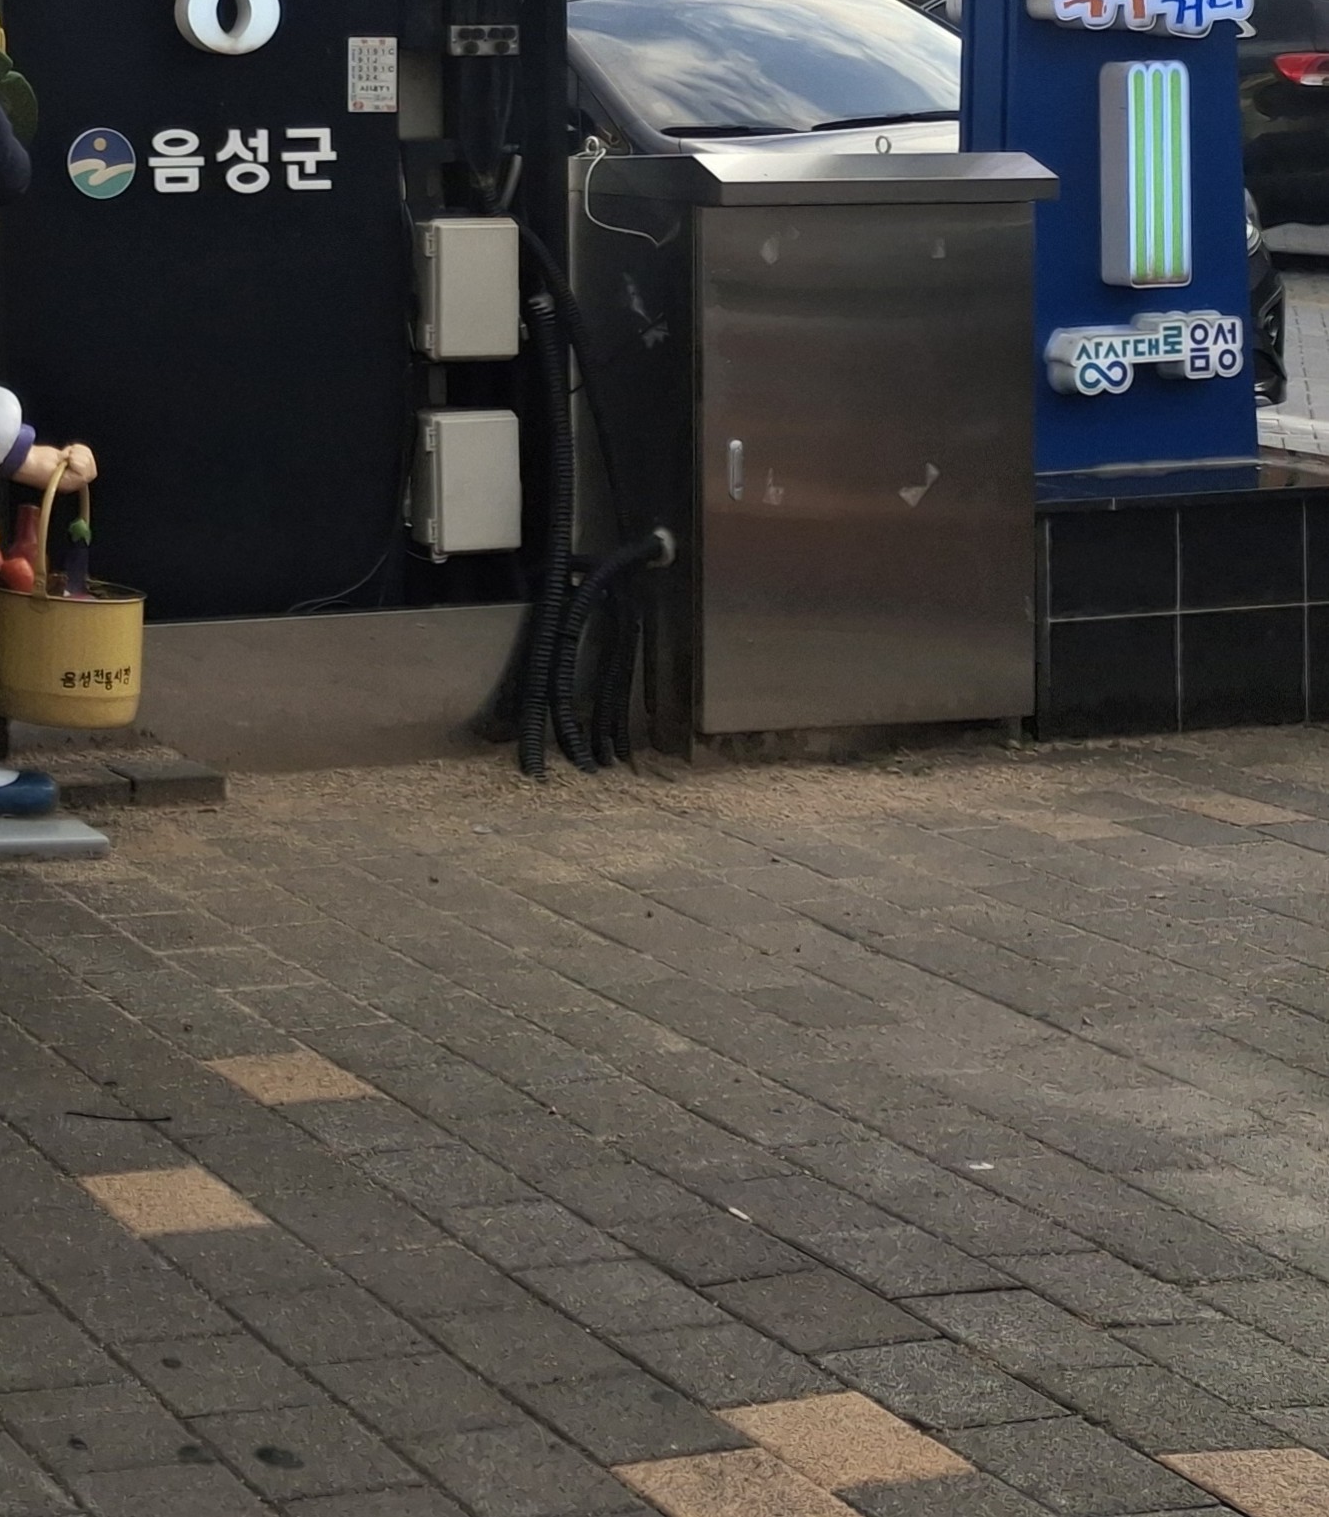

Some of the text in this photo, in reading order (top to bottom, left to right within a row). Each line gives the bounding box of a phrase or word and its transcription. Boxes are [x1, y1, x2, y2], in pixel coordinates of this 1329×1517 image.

[148, 127, 338, 194] 음성군
[1190, 322, 1238, 372] 음성
[60, 666, 131, 691] 음성전통시장
